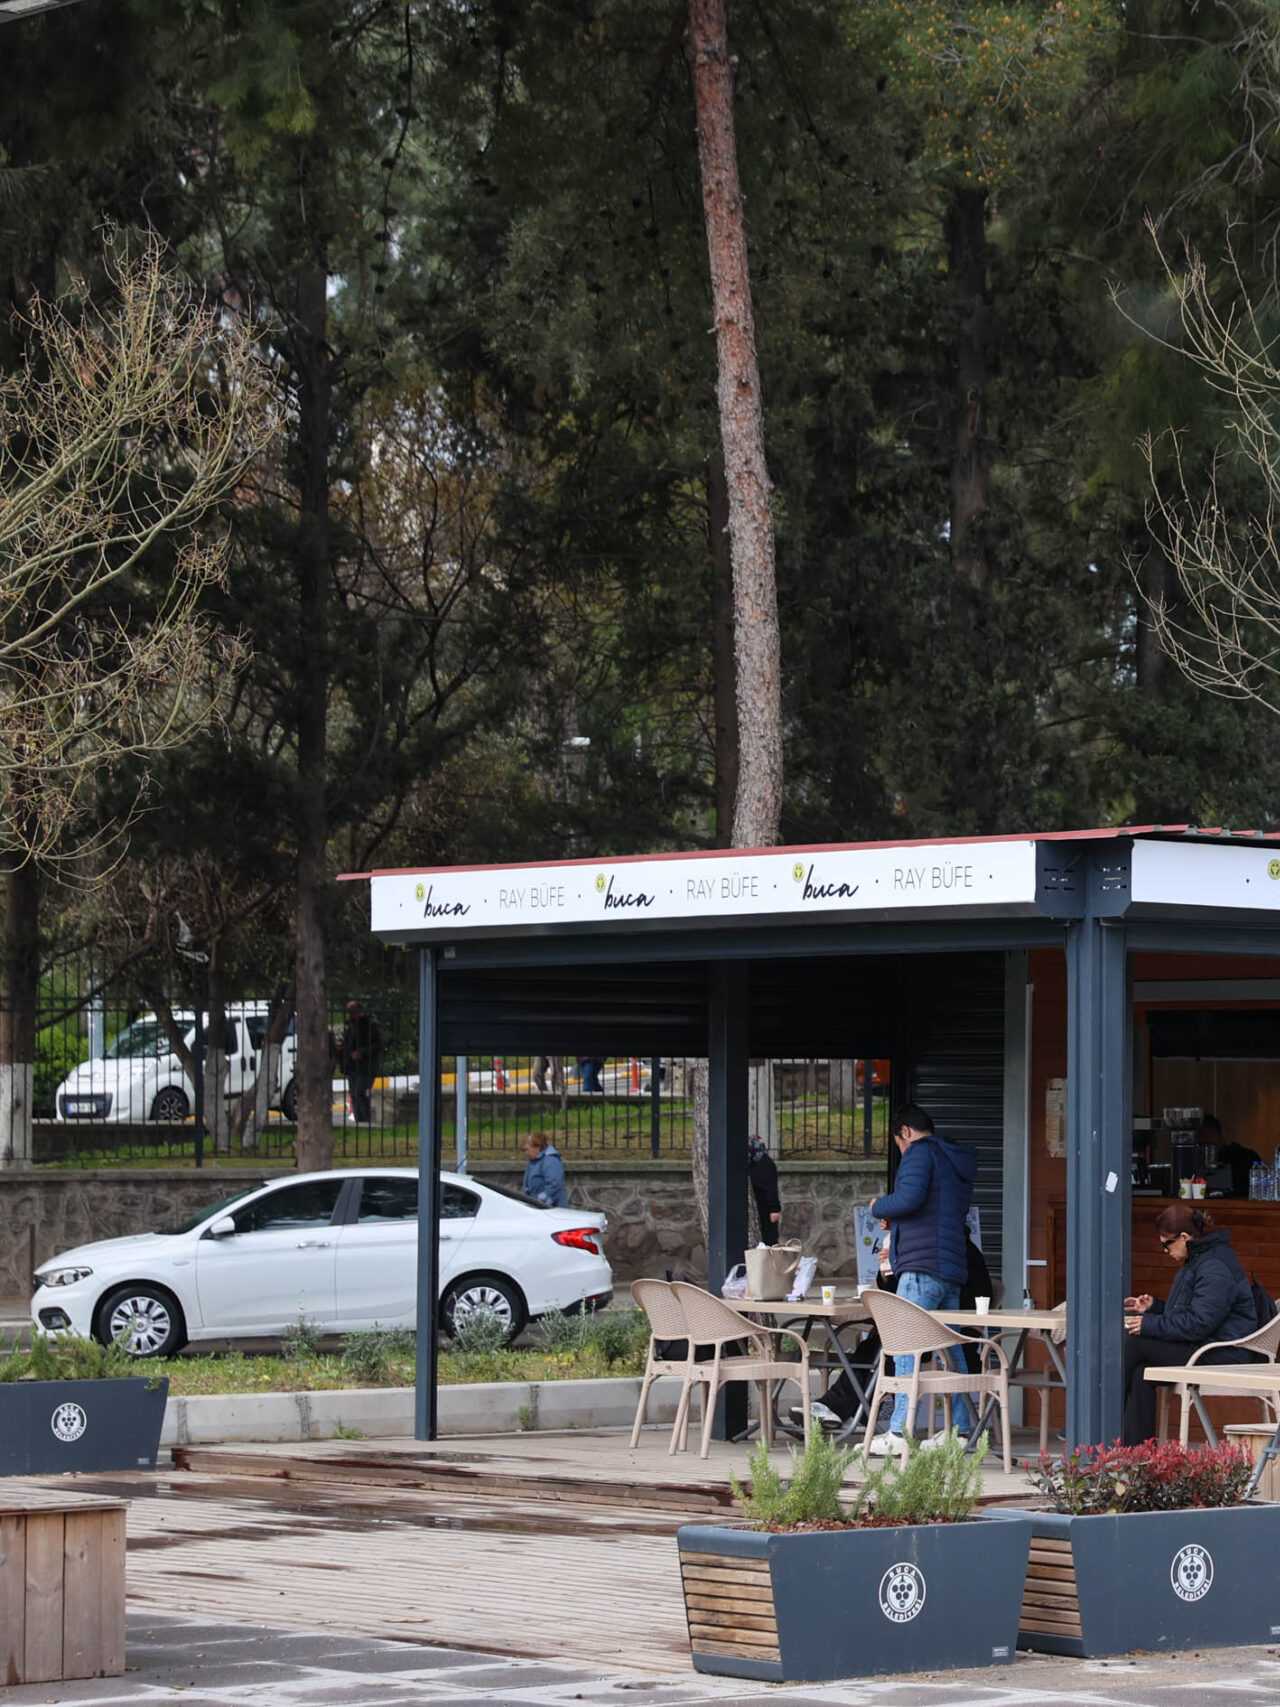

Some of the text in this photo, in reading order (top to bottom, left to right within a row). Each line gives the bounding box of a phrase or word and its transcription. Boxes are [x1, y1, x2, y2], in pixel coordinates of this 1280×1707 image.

[424, 860, 973, 918] buca RAY BÜFE buca RAY BÜFE buca RAY BÜFE
[1180, 1547, 1204, 1559] BUCA
[889, 1566, 915, 1578] BUCA
